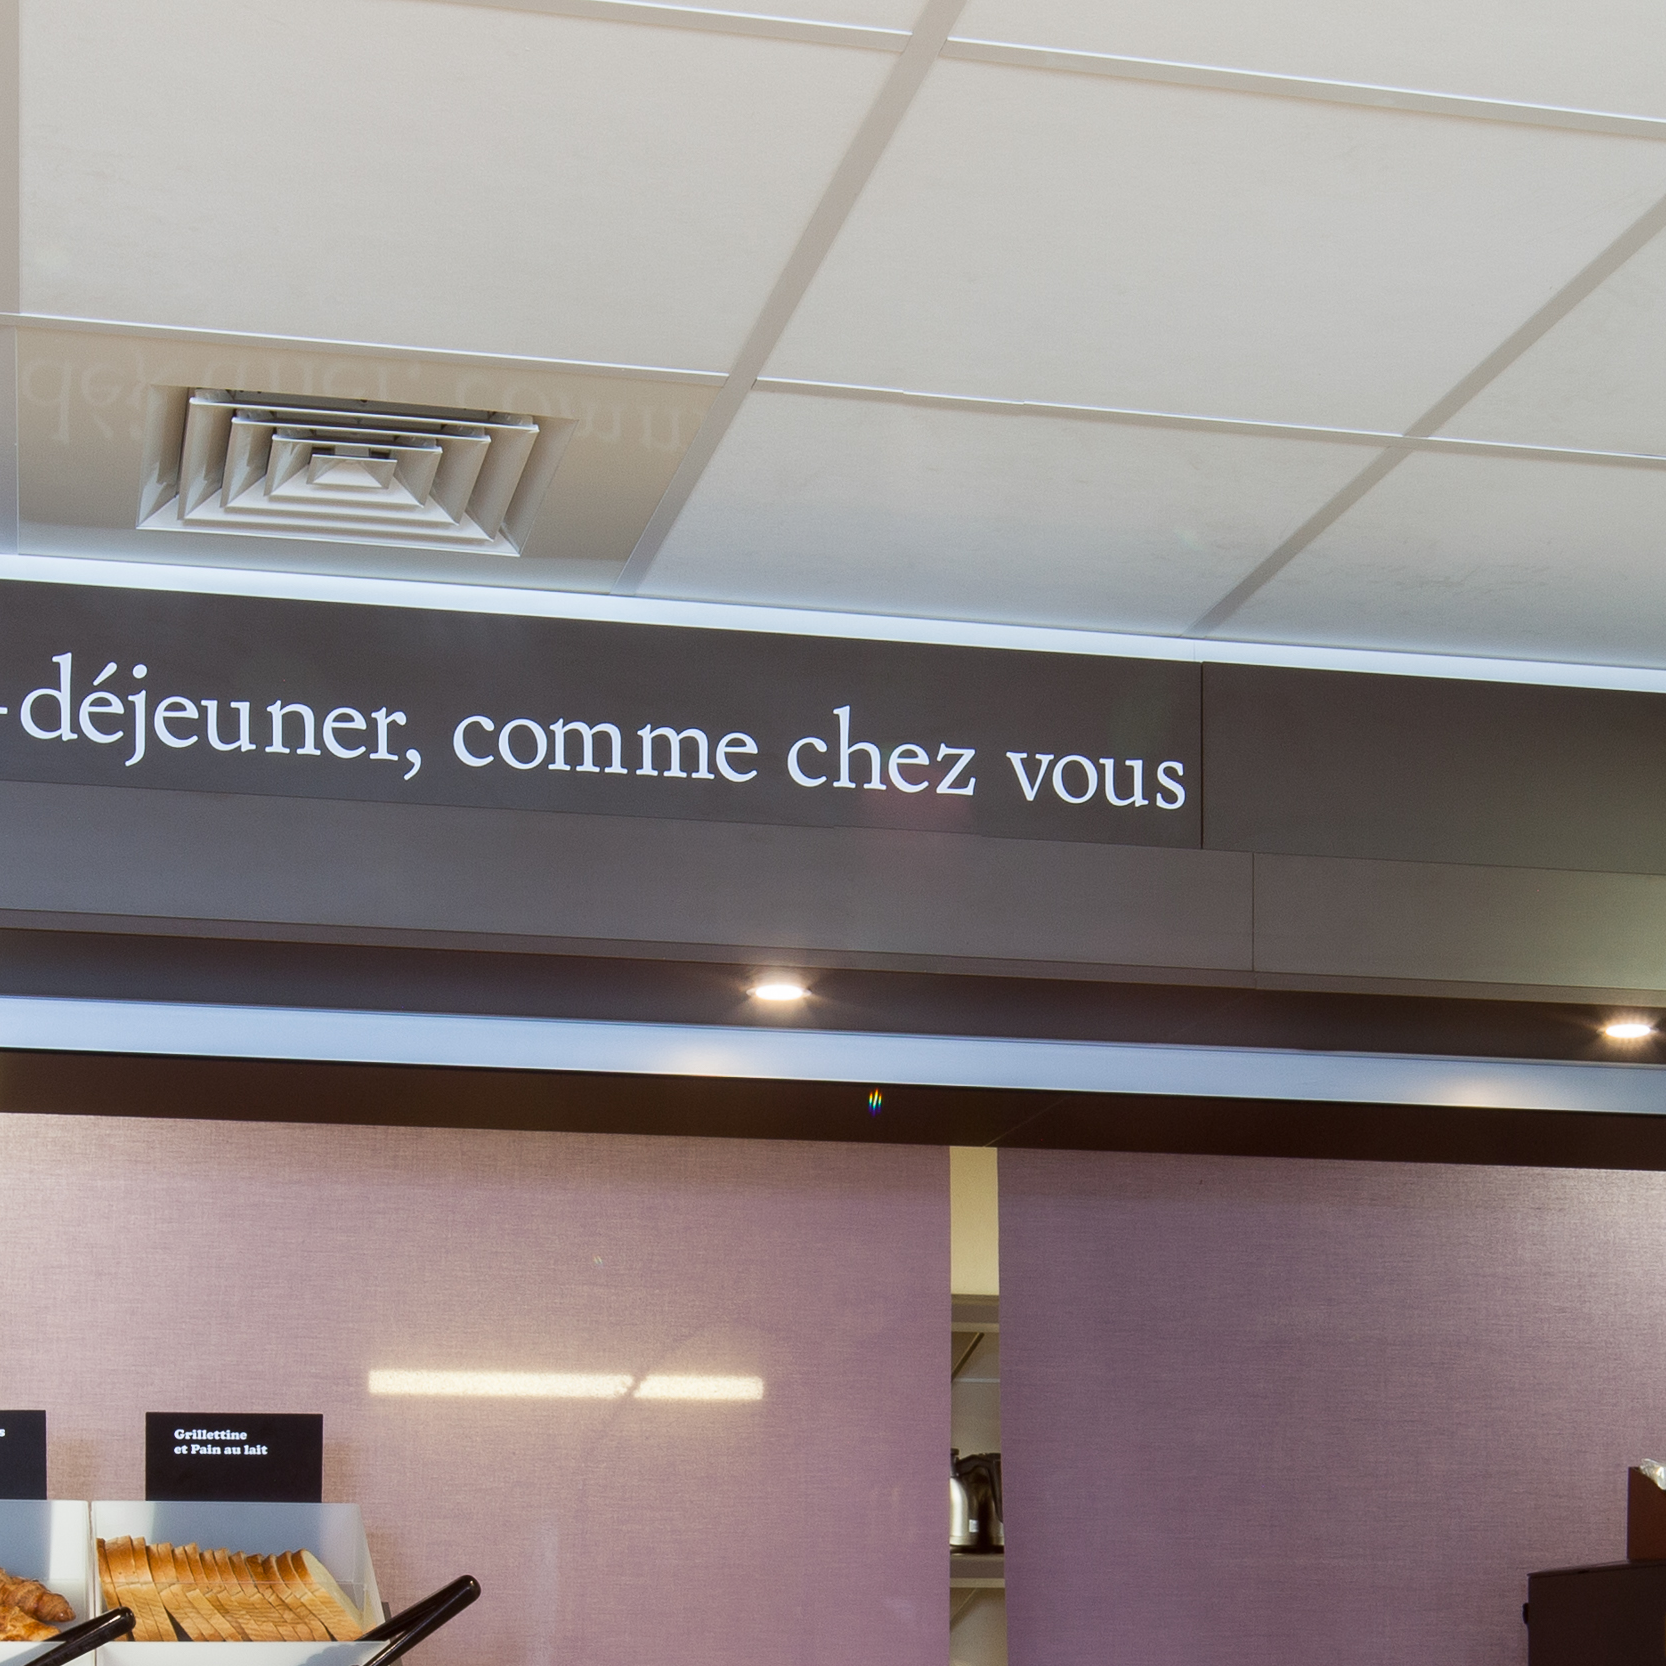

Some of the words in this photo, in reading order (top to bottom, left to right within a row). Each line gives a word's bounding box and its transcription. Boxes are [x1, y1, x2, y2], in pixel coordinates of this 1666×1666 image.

[452, 713, 758, 783] comme
[786, 705, 977, 796] chez
[1005, 748, 1187, 810] vous
[173, 1429, 248, 1441] Grillettine
[173, 1444, 188, 1455] et
[190, 1444, 222, 1455] Pain
[223, 1446, 241, 1456] au
[243, 1444, 268, 1456] lait
